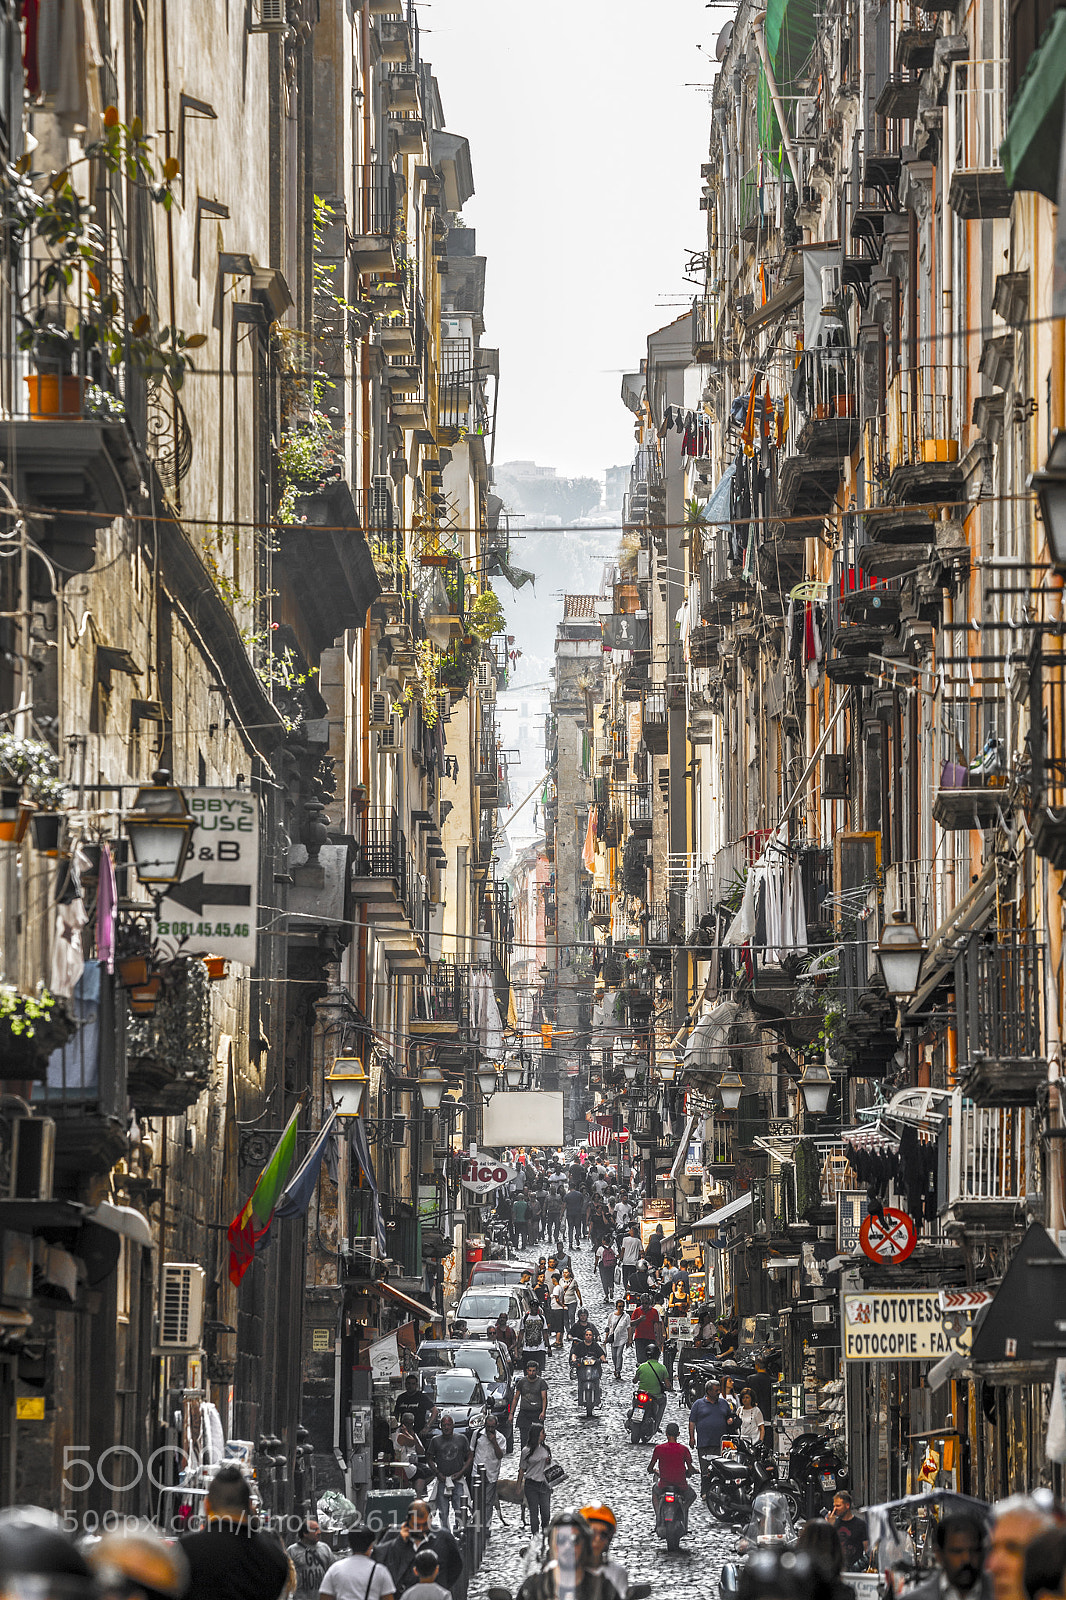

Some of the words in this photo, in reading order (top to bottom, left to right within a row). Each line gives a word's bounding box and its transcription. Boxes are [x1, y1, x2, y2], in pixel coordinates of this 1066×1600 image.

[187, 799, 254, 814] BBY'S
[846, 1195, 867, 1227] T
[873, 1298, 941, 1323] FOTOTESS
[848, 1333, 917, 1354] FOTOCOPIE
[930, 1332, 952, 1352] FAX
